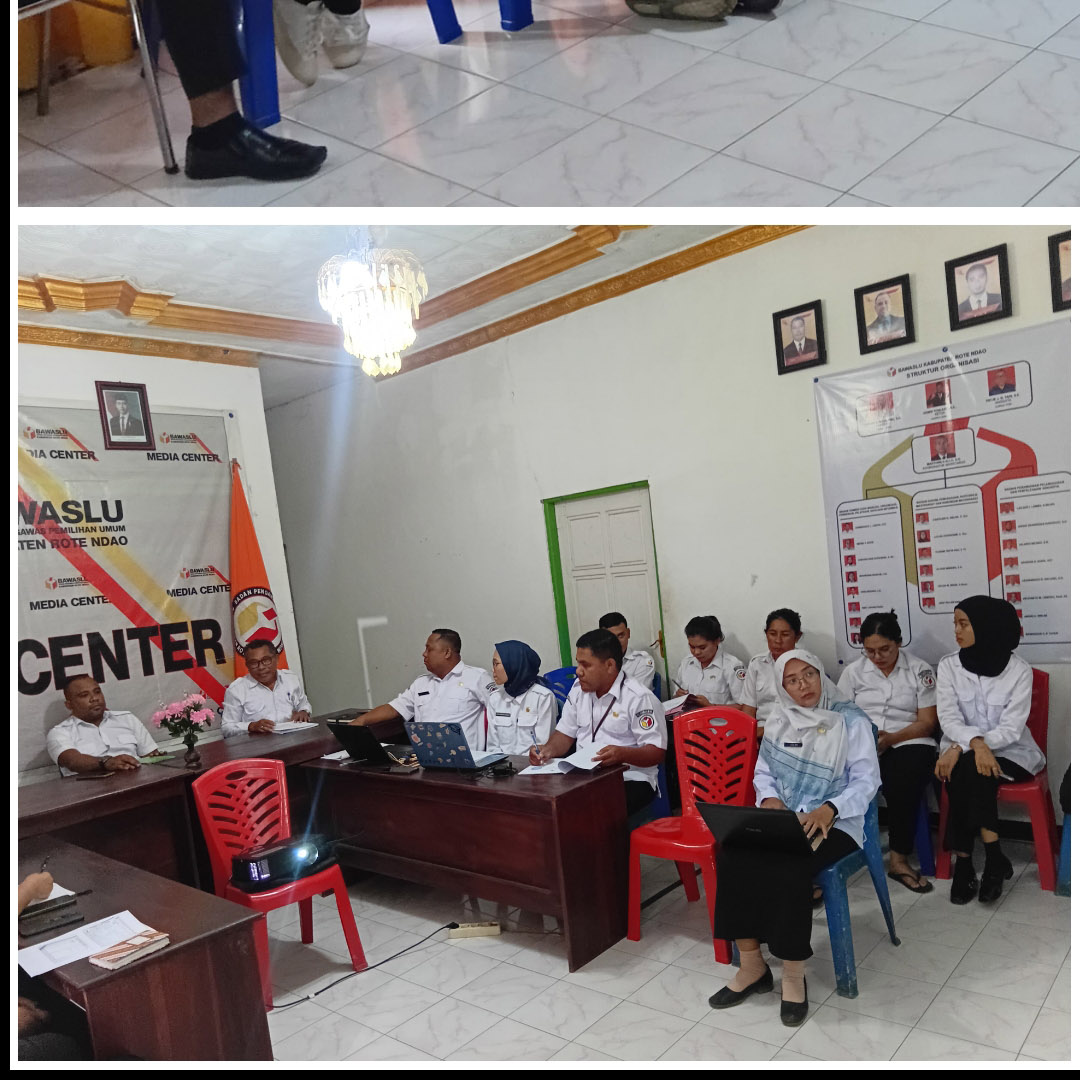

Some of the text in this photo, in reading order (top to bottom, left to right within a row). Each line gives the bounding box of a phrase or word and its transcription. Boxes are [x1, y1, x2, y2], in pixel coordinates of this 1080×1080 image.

[49, 450, 96, 460] CENTER
[146, 452, 219, 462] MEDIA CENTER
[18, 499, 123, 525] WASLU
[48, 526, 97, 535] PEMILIHAN
[99, 525, 126, 533] UMUM
[51, 538, 88, 549] ROTE
[91, 536, 128, 547] NDAO
[166, 584, 231, 597] MEDIA CENTE
[30, 595, 111, 611] MEDIA CENTE
[18, 618, 227, 696] CENTER
